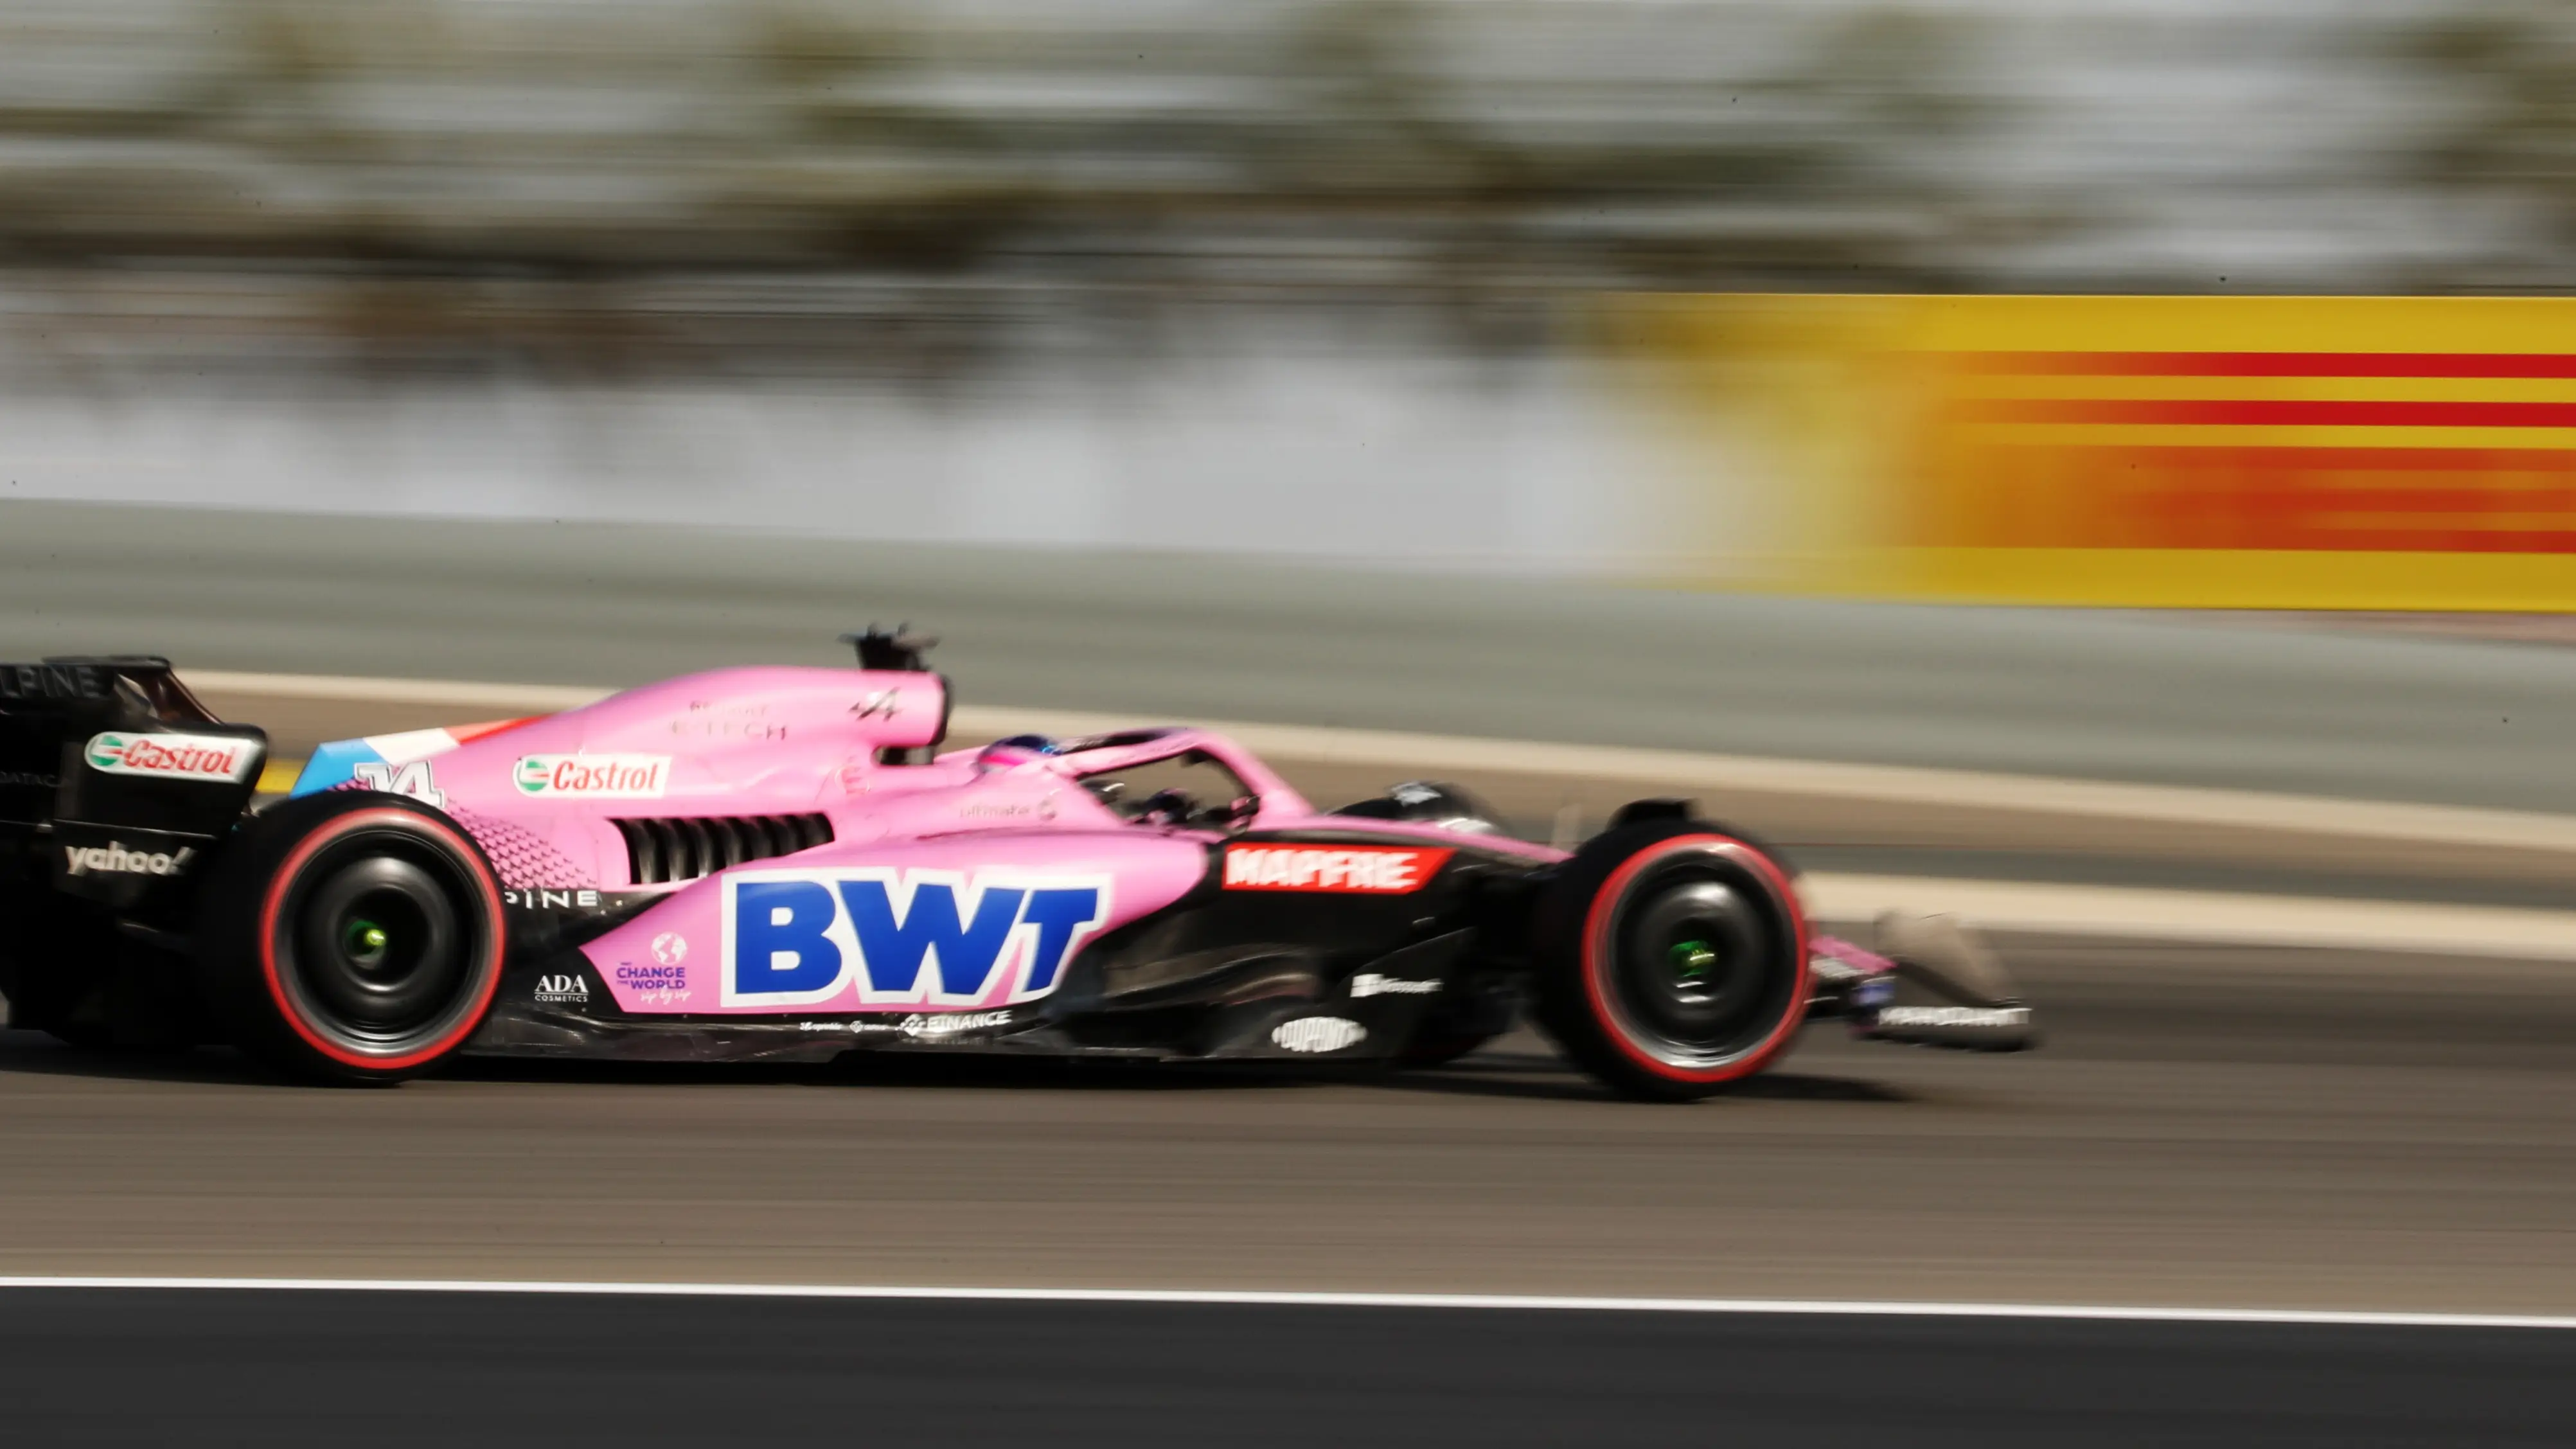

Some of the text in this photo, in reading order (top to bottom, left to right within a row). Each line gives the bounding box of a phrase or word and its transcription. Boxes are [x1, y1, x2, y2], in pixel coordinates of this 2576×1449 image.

[123, 740, 236, 774] Castrol
[553, 760, 659, 791] Castrol
[65, 841, 197, 875] yahoo!
[735, 880, 1098, 995] BWT
[535, 975, 589, 993] ADA
[616, 967, 686, 978] CHANGE
[630, 979, 686, 990] WORLD
